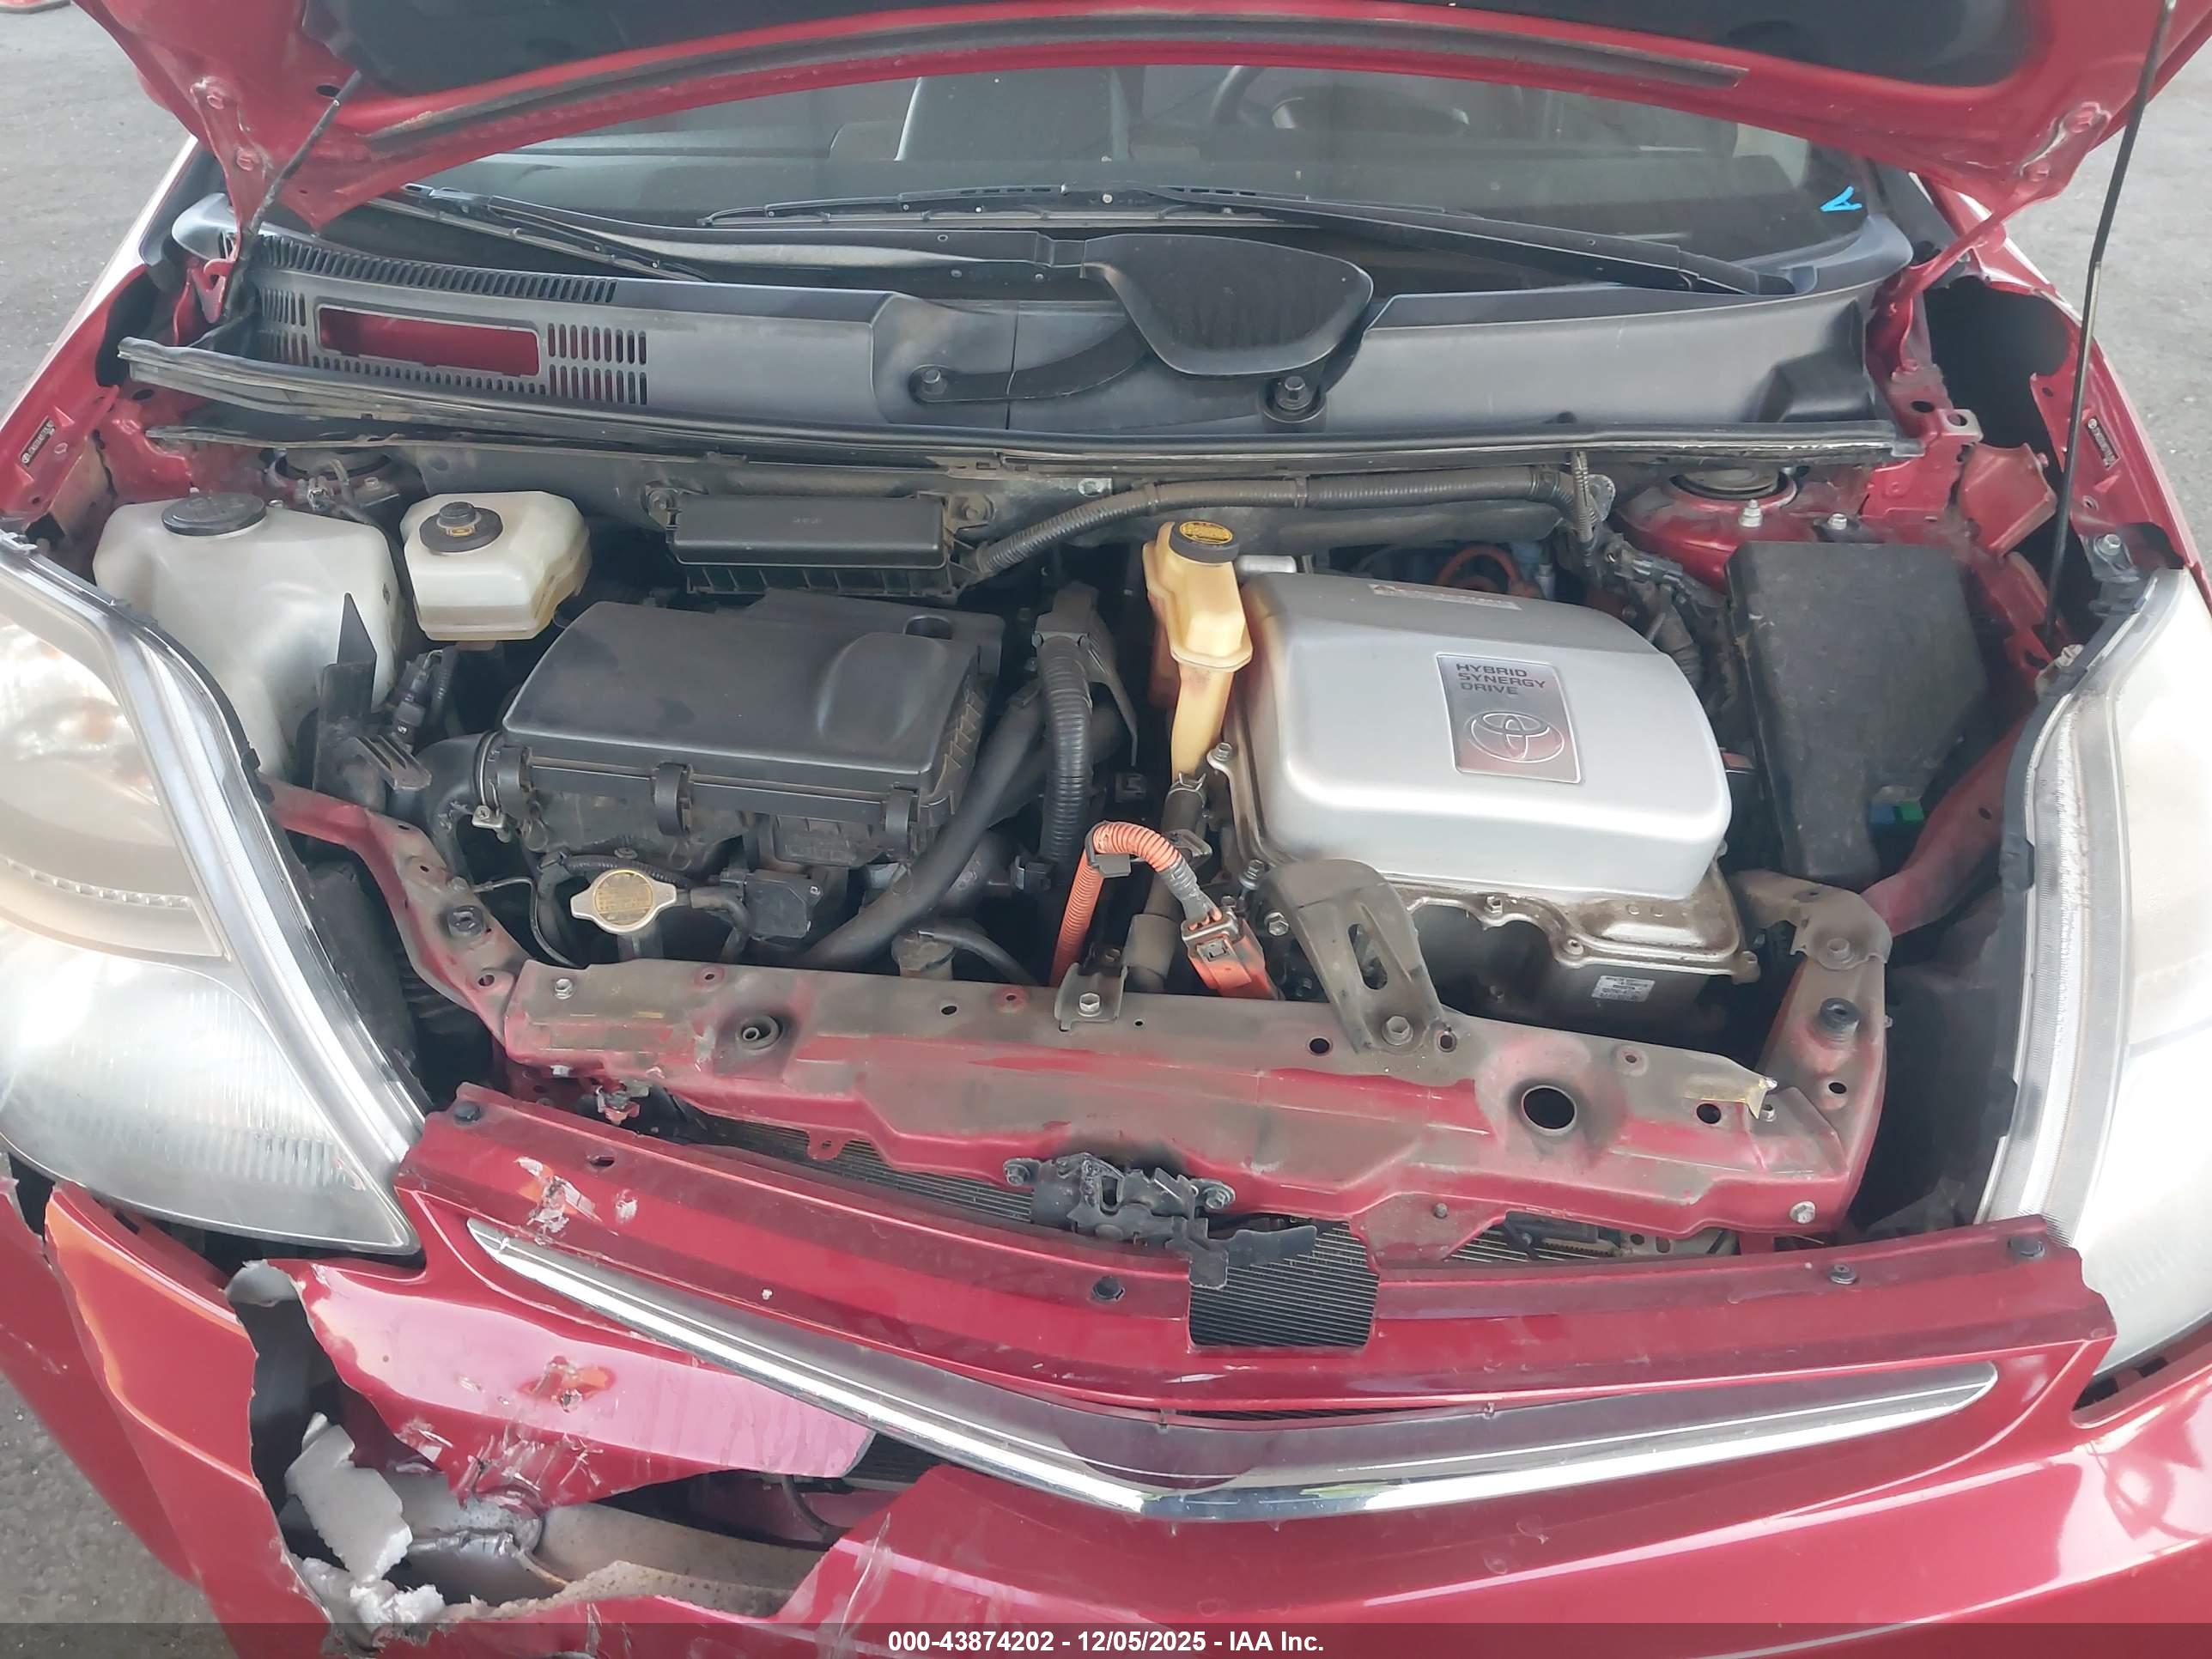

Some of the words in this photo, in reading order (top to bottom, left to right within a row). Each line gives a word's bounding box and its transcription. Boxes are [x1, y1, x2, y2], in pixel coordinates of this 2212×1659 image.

[1455, 663, 1528, 678] HYBRID
[1457, 672, 1546, 689] SYNERGY
[1460, 682, 1519, 696] DRIVE
